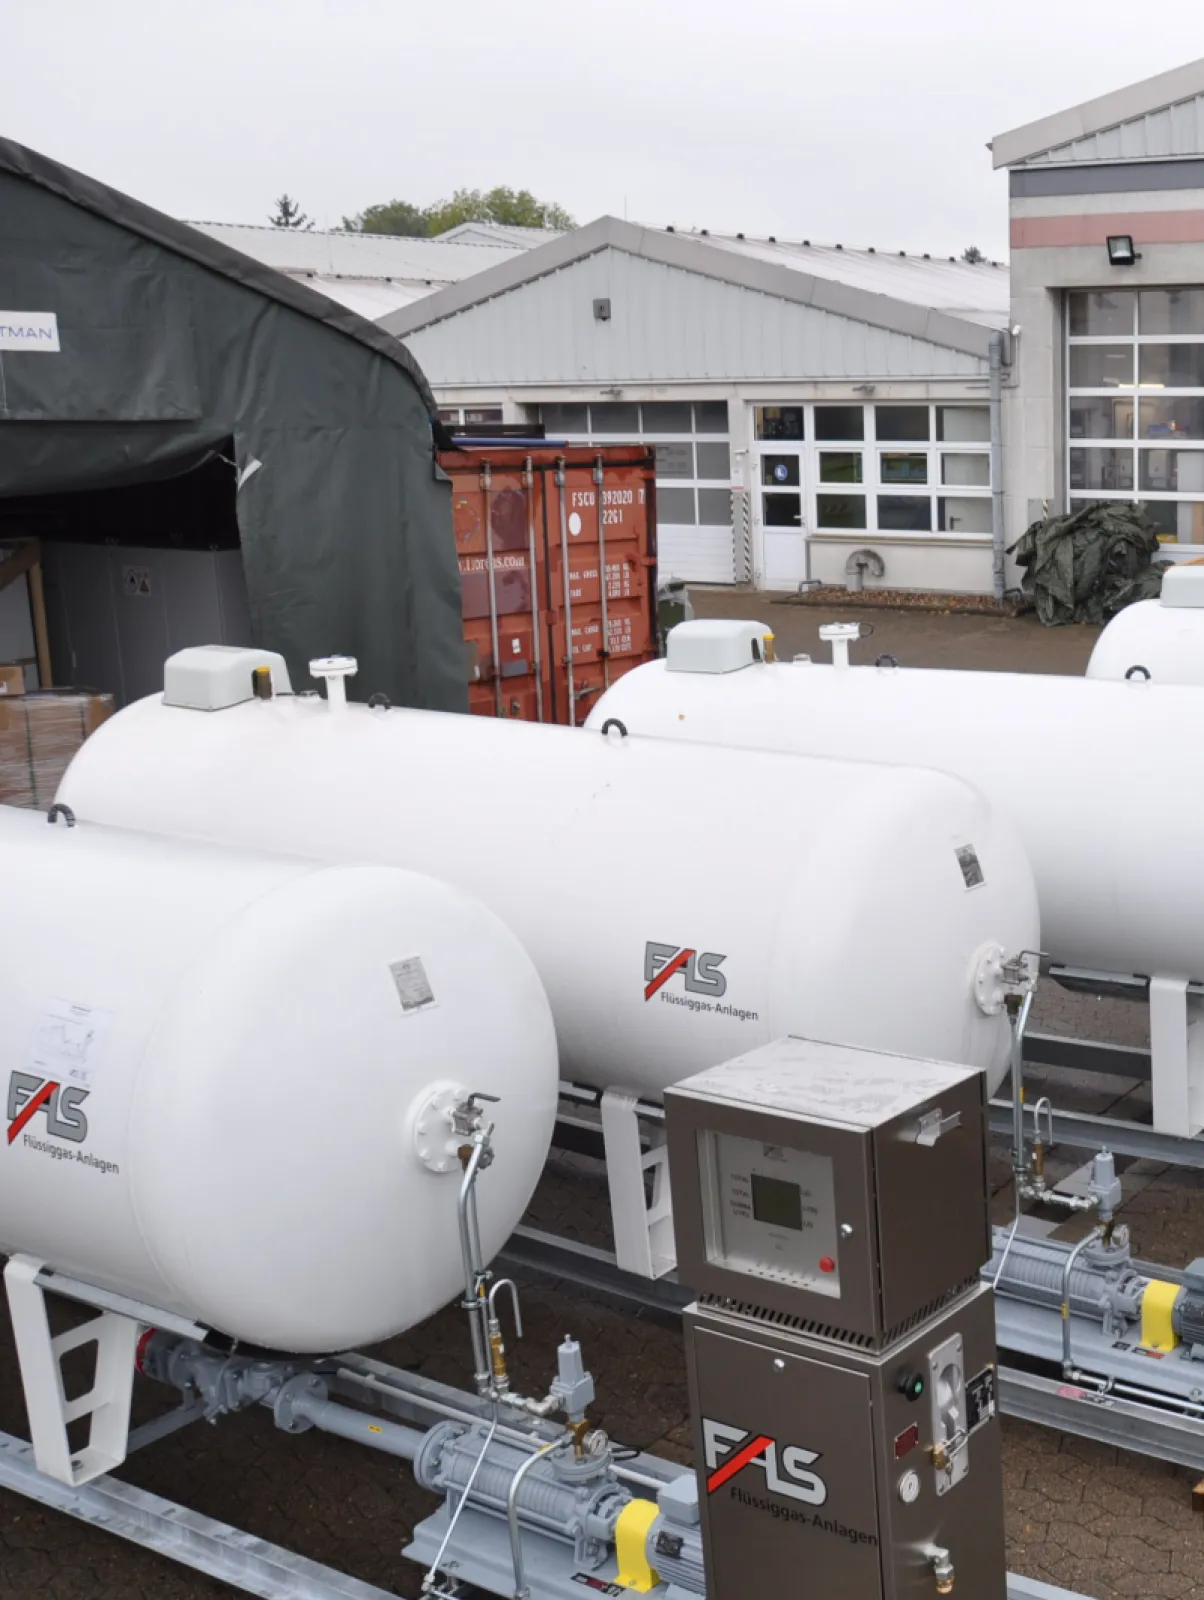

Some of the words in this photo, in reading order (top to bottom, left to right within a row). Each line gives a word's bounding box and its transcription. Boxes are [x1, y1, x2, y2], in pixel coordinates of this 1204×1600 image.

[644, 941, 728, 1002] FAS
[660, 991, 759, 1021] Flüssiggas-Anlagen
[7, 1069, 91, 1145] FAS
[23, 1133, 120, 1175] Flüssiggas-Anlagen
[701, 1415, 828, 1507] FAS
[730, 1486, 878, 1547] Flüssiggas-Anlagen
